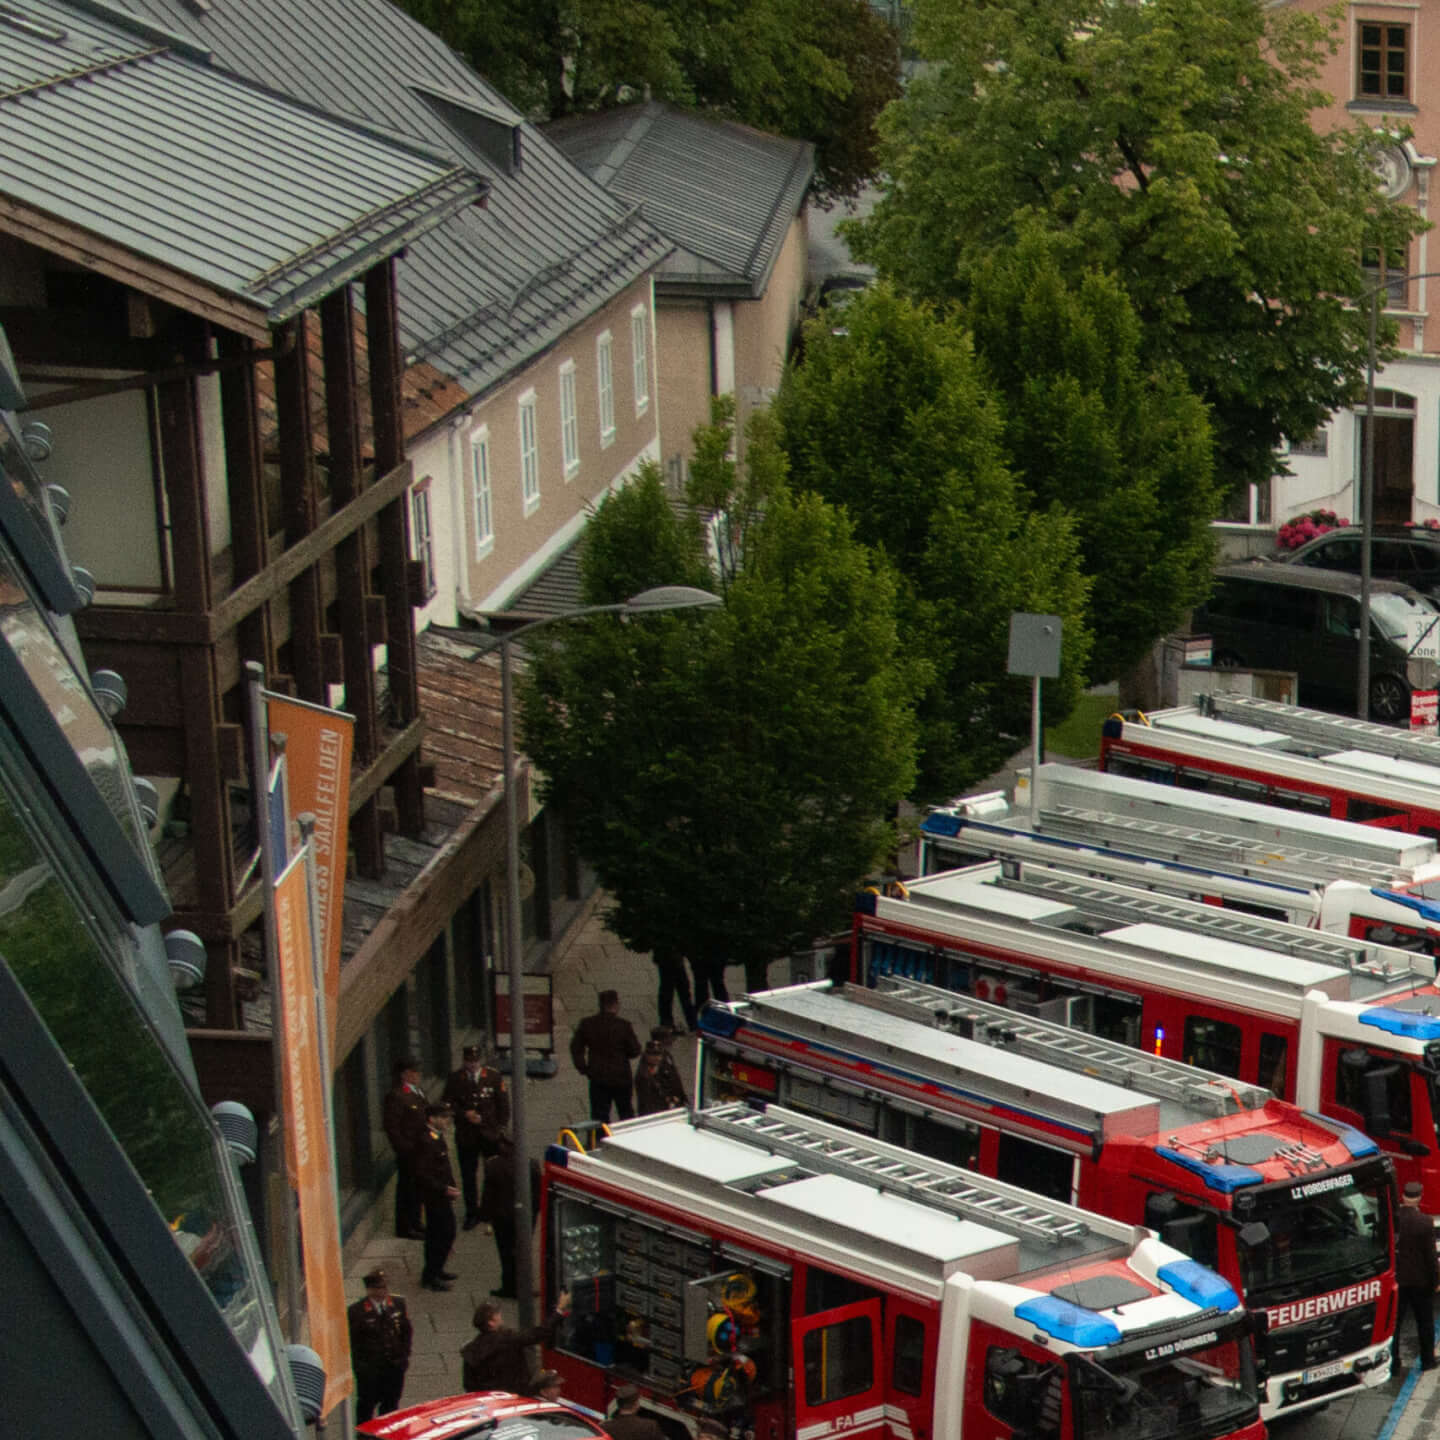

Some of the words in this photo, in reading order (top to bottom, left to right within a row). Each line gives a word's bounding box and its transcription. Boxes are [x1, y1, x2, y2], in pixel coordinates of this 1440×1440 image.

[315, 728, 341, 856] SAALFELDEN
[1291, 1187, 1303, 1199] LZ
[1267, 1280, 1382, 1328] FEUERWEHR
[1158, 1342, 1174, 1355] BAD
